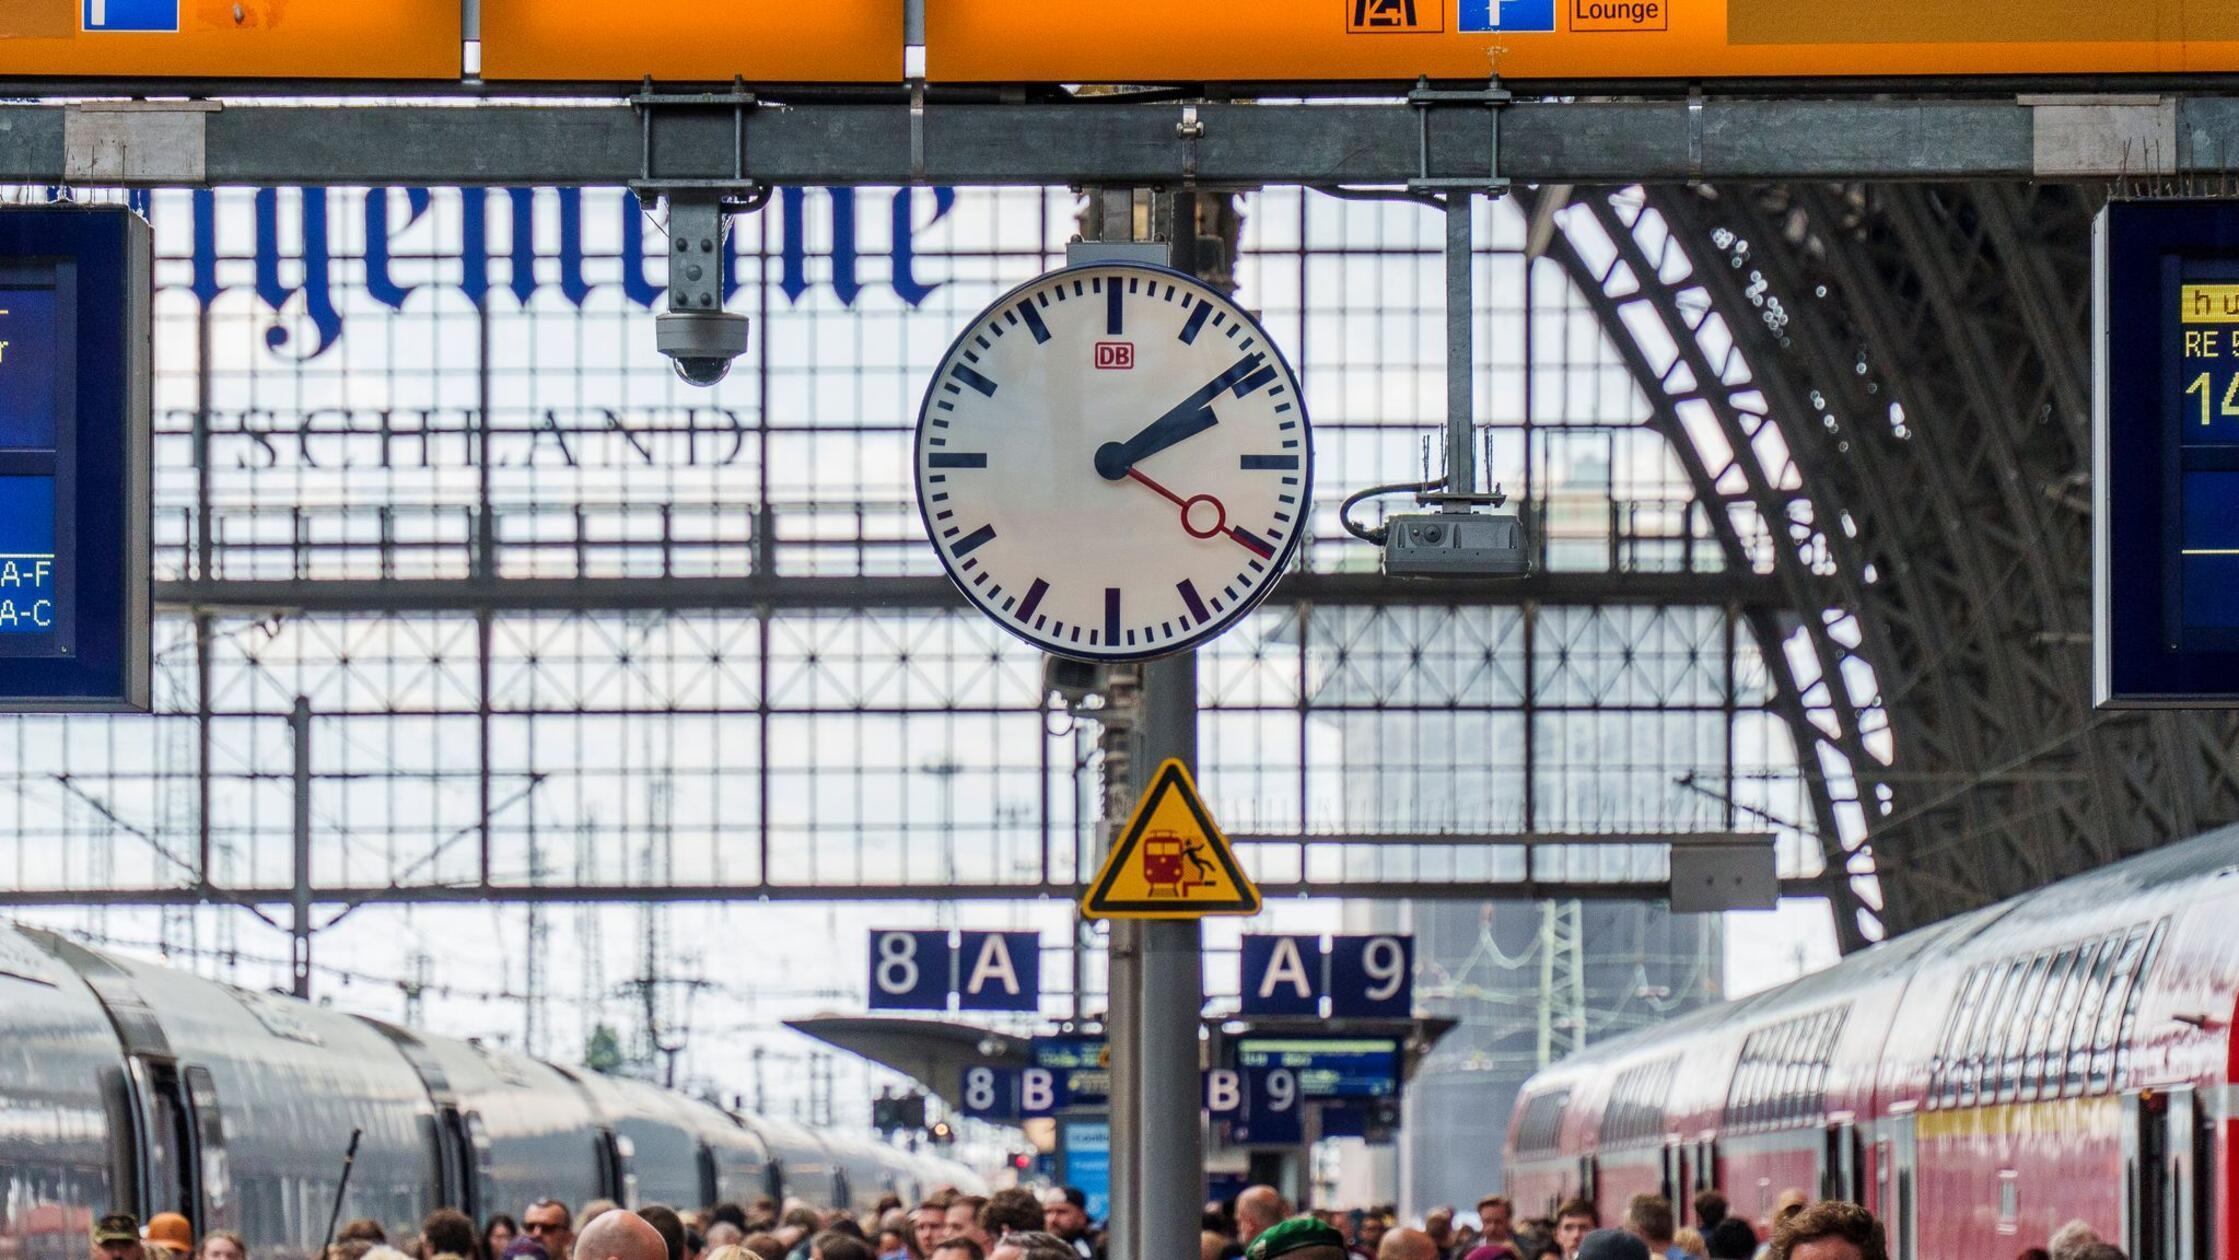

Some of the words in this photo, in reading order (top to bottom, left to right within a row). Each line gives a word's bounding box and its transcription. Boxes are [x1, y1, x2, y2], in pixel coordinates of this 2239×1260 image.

[1576, 0, 1658, 22] Lounge
[1100, 347, 1129, 365] DB
[2185, 331, 2219, 357] RE
[0, 561, 52, 588] A-F
[0, 600, 51, 626] A-C
[877, 932, 919, 994] 8
[967, 933, 1020, 995] A
[1259, 937, 1311, 998] A
[1363, 938, 1404, 1000] 9
[965, 1068, 994, 1110] 8
[1022, 1069, 1054, 1110] B
[1207, 1069, 1240, 1112] B
[1266, 1069, 1295, 1111] 9
